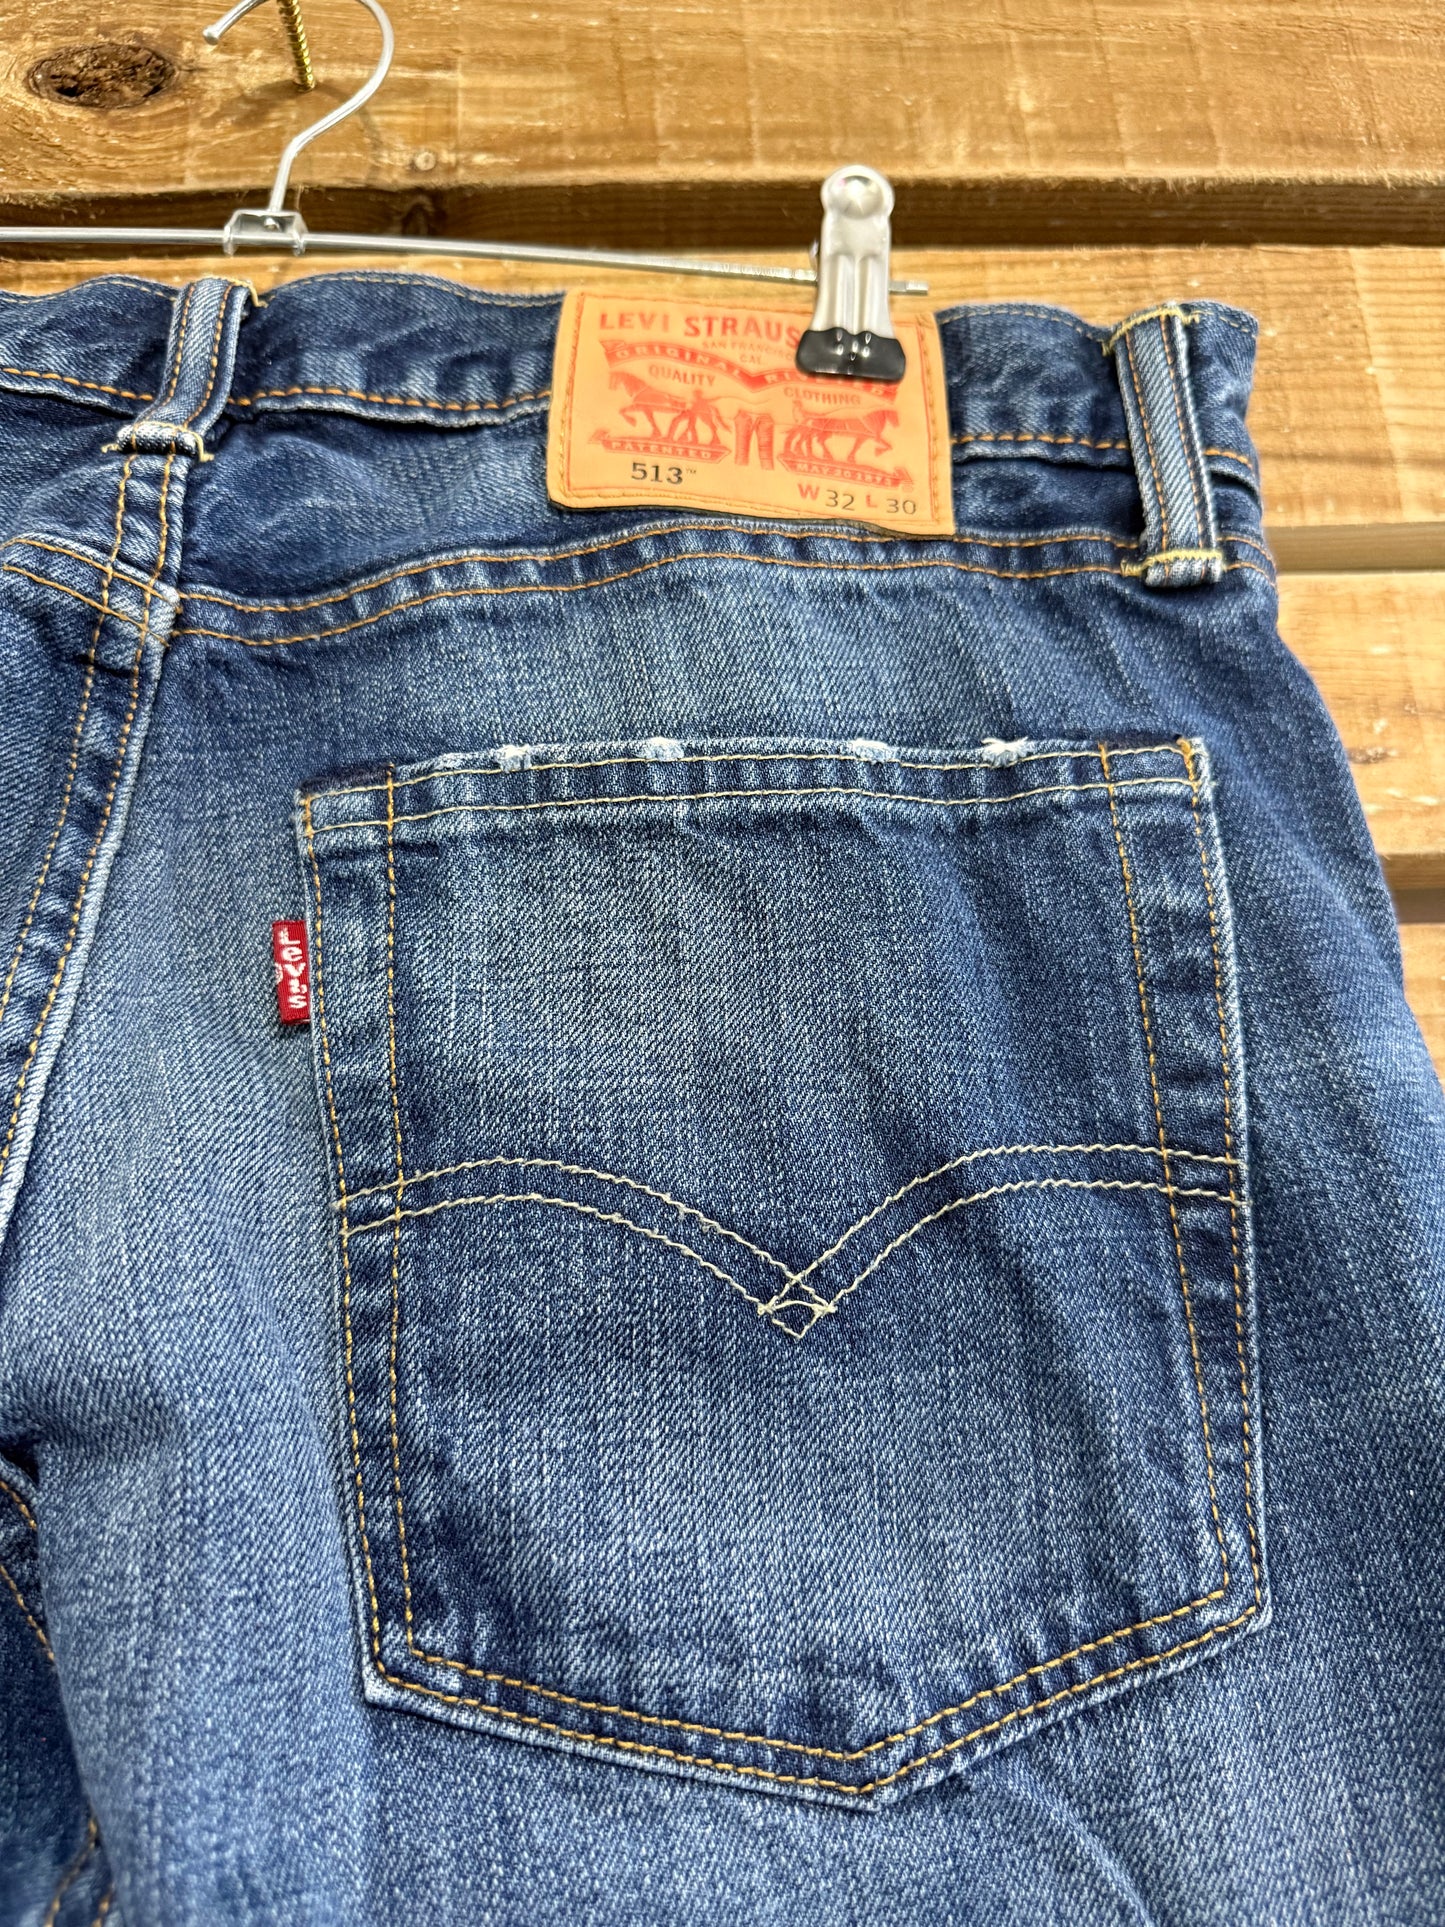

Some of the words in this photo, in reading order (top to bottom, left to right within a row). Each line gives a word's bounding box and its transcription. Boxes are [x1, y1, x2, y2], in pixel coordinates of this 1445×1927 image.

[599, 312, 670, 333] LEVI
[684, 315, 801, 349] STRAUS
[616, 345, 742, 378] ORIGINAL
[648, 364, 716, 387] QUALITY
[783, 386, 862, 405] CLOTHING
[611, 441, 712, 459] PATENTED
[796, 463, 830, 475] MAY
[834, 468, 852, 478] 20
[797, 483, 820, 501] W
[825, 489, 856, 511] 32
[865, 494, 878, 508] L
[886, 498, 917, 515] 30
